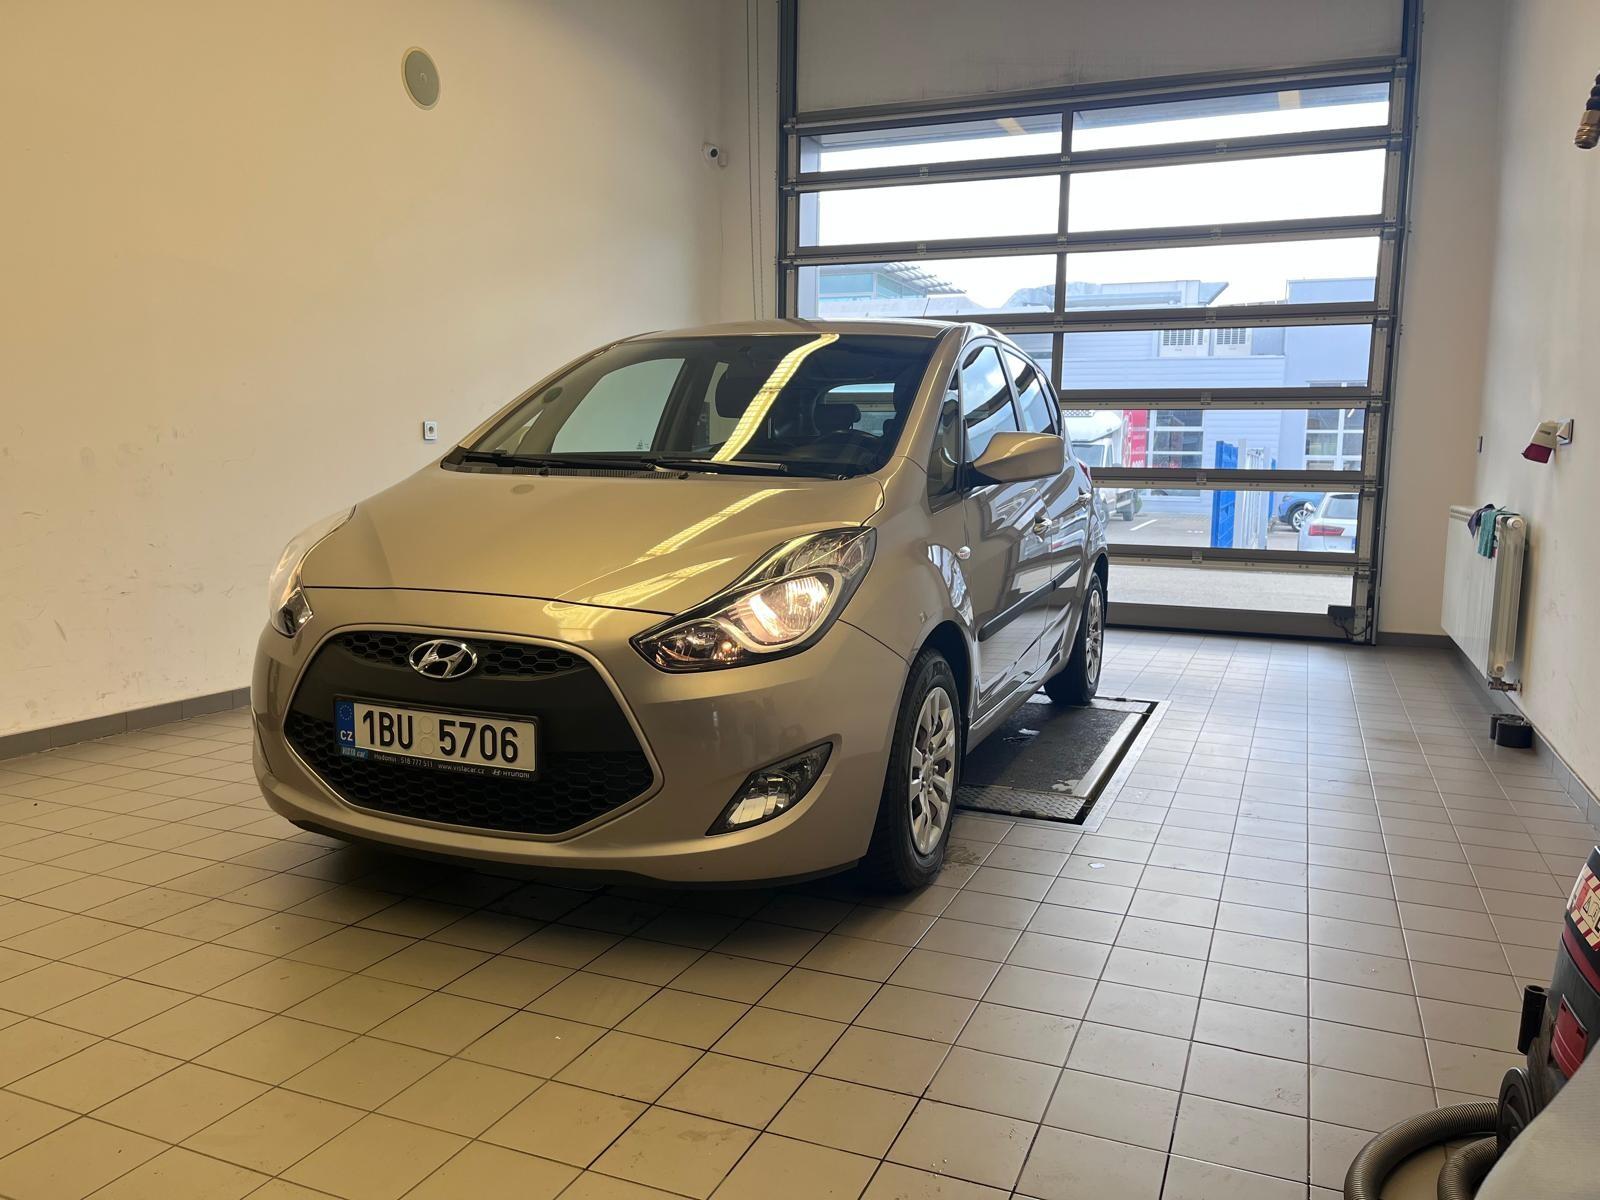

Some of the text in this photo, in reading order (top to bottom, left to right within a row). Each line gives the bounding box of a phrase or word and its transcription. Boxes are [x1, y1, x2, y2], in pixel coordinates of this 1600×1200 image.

[340, 730, 354, 741] CZ
[362, 709, 519, 764] 1BU 5706
[411, 758, 422, 767] 777
[423, 760, 433, 768] 511
[437, 763, 485, 775] www.vistacar.cz
